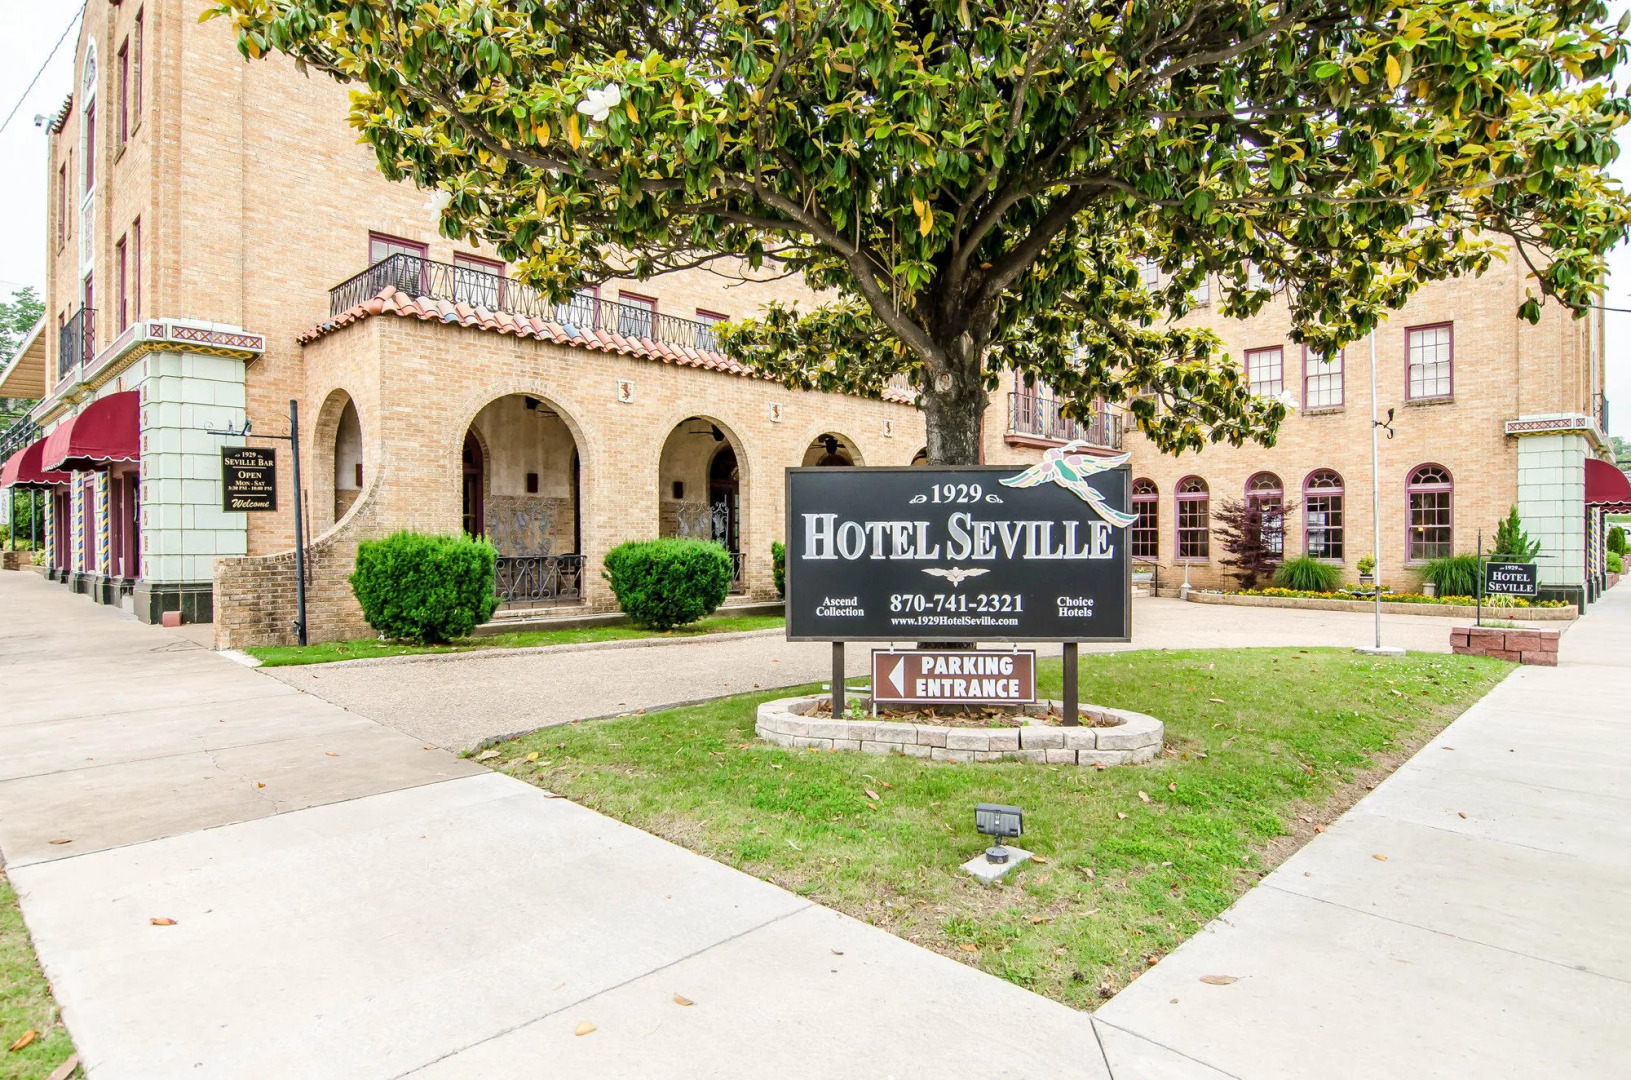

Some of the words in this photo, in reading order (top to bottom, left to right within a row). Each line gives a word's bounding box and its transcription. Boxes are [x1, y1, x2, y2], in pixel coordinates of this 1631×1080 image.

[931, 484, 982, 504] 1929
[231, 498, 270, 508] Welcome
[801, 513, 940, 560] HOTEL
[947, 512, 1114, 560] SEVILLE
[1493, 572, 1530, 582] HOTEL
[1488, 582, 1533, 592] SEVILLE
[822, 596, 858, 607] Ascend
[890, 594, 1024, 612] 870-741-2321
[1057, 596, 1094, 607] Choice
[816, 607, 864, 618] Collection
[1058, 607, 1092, 618] Hotels
[891, 616, 1018, 626] www.1929HotelSeville.com
[921, 656, 1014, 675] PARKING
[916, 679, 1019, 698] ENTRANCE
